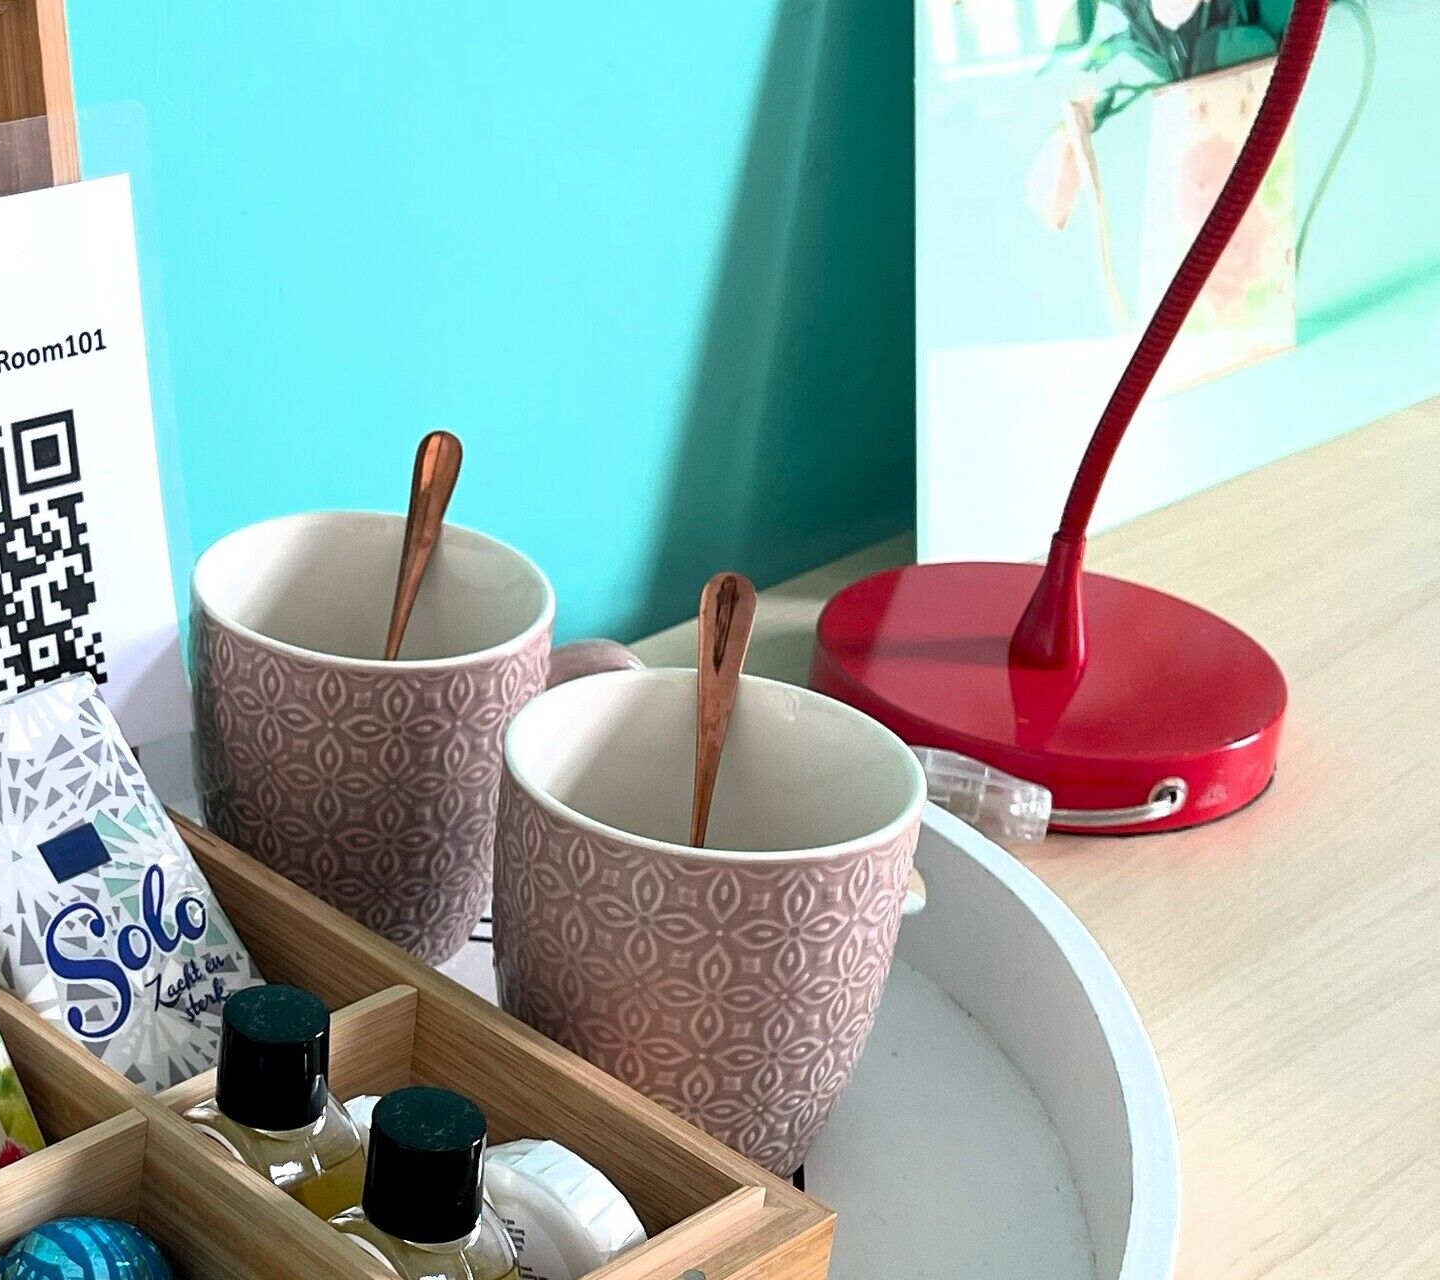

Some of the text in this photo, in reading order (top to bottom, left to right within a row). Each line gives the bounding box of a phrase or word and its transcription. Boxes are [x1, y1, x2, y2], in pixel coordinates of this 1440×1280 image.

[46, 864, 207, 1038] Solo
[144, 954, 226, 1012] Zacht en
[184, 976, 232, 1023] sterk
